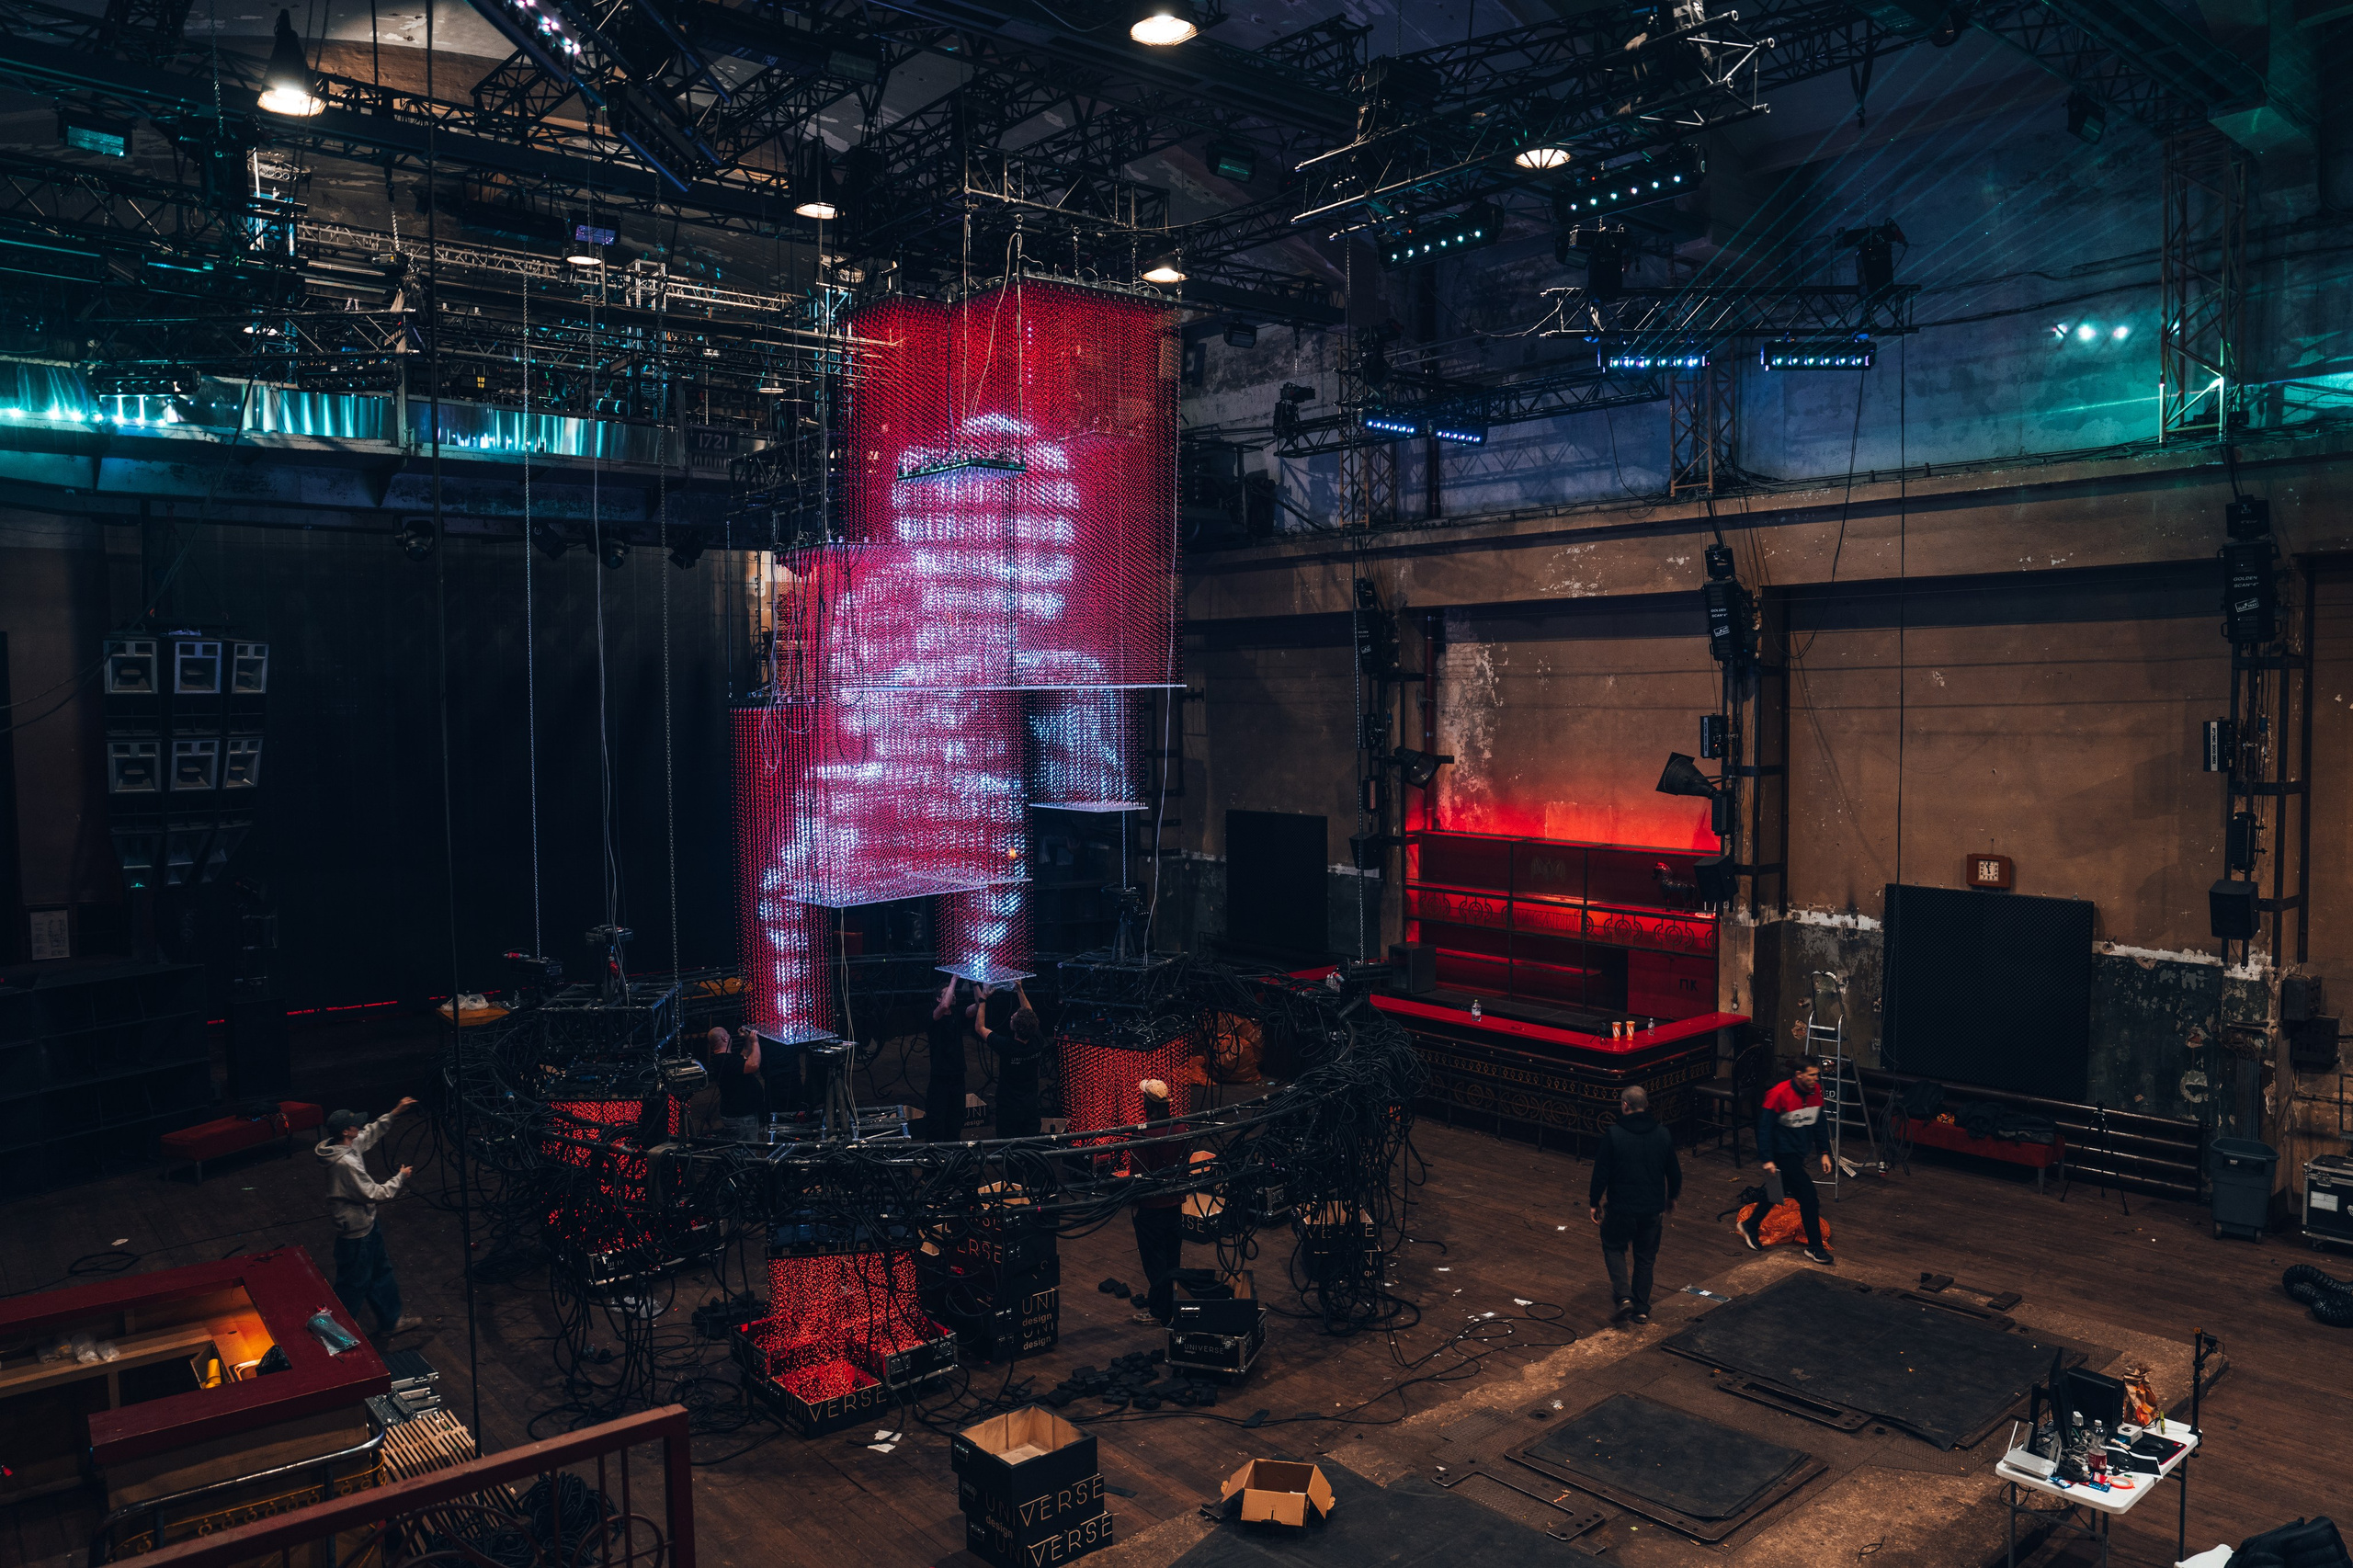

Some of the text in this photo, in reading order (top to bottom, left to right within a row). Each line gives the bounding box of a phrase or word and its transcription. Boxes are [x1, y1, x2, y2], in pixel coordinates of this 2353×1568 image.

[699, 432, 729, 449] 1721
[1022, 1290, 1055, 1315] UNI
[1022, 1312, 1052, 1327] design
[1023, 1335, 1051, 1351] design
[1184, 1343, 1224, 1355] UNIVERSE
[985, 1515, 1013, 1540] design
